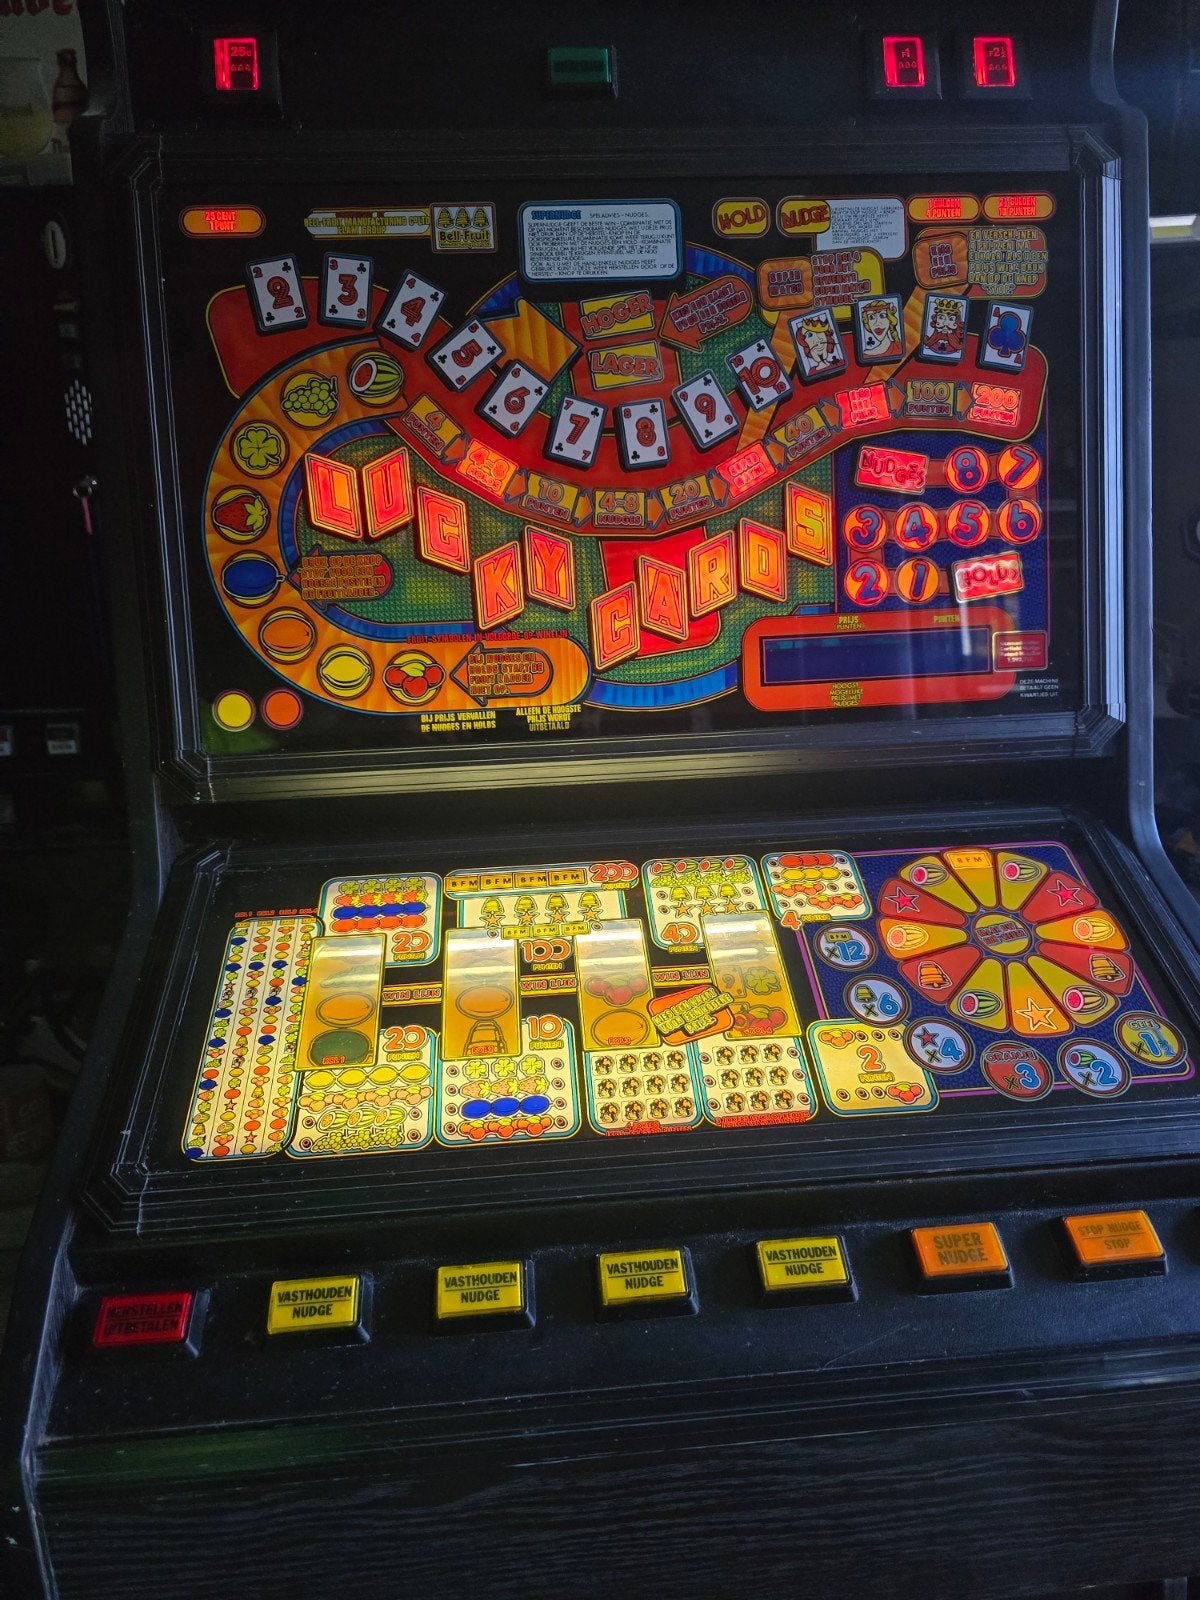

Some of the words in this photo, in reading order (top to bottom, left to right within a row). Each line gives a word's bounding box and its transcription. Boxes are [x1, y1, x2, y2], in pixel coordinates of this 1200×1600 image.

[934, 199, 961, 208] GULDEN
[1008, 207, 1036, 216] PUNTEN
[1009, 197, 1036, 208] GULDEN
[216, 211, 236, 221] CENT
[345, 216, 408, 227] MANUFACTURING
[531, 210, 581, 220] SUPERNUDGE
[717, 205, 767, 231] HOLD
[781, 204, 831, 230] NUDGE
[932, 208, 961, 217] PUNTEN
[362, 226, 386, 235] GROUP
[440, 230, 490, 241] Bell-Fruit
[812, 254, 835, 266] STOP
[770, 270, 802, 283] SUPER
[814, 273, 858, 285] GEWENSTE
[1015, 274, 1038, 283] KNOP
[267, 276, 294, 309] 2
[338, 274, 358, 305] 3
[770, 283, 803, 296] MATCH
[815, 285, 842, 296] SUPER
[843, 280, 870, 293] MATCH
[401, 297, 426, 327] 4
[580, 294, 656, 335] HOGER
[451, 339, 482, 367] 5
[591, 352, 660, 378] LAGER
[738, 356, 781, 395] 10
[504, 386, 530, 414] 6
[911, 381, 951, 402] 100
[976, 386, 1019, 410] 200
[694, 393, 717, 424] 9
[908, 403, 951, 415] PUNTEN
[973, 407, 1015, 423] PUNTEN
[426, 411, 446, 430] 4
[566, 413, 590, 444] 7
[784, 414, 814, 441] 40
[405, 412, 446, 452] PUNTEN
[635, 416, 657, 447] 8
[788, 427, 829, 457] PUNTEN
[860, 449, 926, 488] NUDGES
[955, 448, 983, 490] 8
[1004, 445, 1037, 487] 7
[466, 465, 503, 492] HOLDS
[539, 478, 564, 503] 10
[669, 479, 700, 504] 20
[527, 497, 570, 520] PUNTEN
[599, 491, 640, 512] 4-8
[668, 496, 711, 521] PUNTEN
[598, 513, 643, 525] NUDGES
[851, 507, 881, 548] 3
[901, 507, 932, 546] 4
[953, 503, 983, 545] 5
[1006, 501, 1037, 541] 6
[313, 458, 572, 622] LUCKY
[355, 554, 382, 566] KNOP
[596, 492, 828, 660] CARDS
[852, 562, 886, 603] 2
[911, 561, 930, 602] 1
[838, 616, 859, 624] PRIJS
[933, 615, 961, 624] PUNTEN
[407, 635, 429, 644] FRUIT
[485, 633, 522, 642] VOLGORDE
[536, 630, 569, 640] WINLIJN
[468, 654, 484, 665] BIJ
[486, 653, 521, 664] NUDGES
[468, 664, 498, 675] HOLDS
[531, 662, 544, 673] DE
[469, 675, 494, 685] FRUIT
[470, 685, 492, 695] NIET
[421, 714, 433, 724] BIJ
[434, 713, 455, 723] PRIJS
[457, 711, 496, 721] VERVALLEN
[516, 707, 542, 717] ALLEEN
[543, 706, 552, 715] DE
[552, 704, 582, 714] HOOGSTE
[527, 715, 546, 724] PRIJS
[547, 713, 571, 723] WORDT
[421, 723, 432, 733] DE
[434, 722, 460, 732] NUDGES
[462, 721, 473, 731] EN
[474, 720, 497, 730] HOLDS
[529, 722, 570, 732] UITBETAALD
[590, 864, 639, 883] 200
[781, 910, 802, 930] 4
[661, 922, 699, 944] 40
[391, 931, 432, 955] 20
[521, 938, 572, 962] 100
[393, 952, 425, 961] PUNTEN
[533, 962, 563, 971] PUNTEN
[654, 971, 681, 981] WIN
[682, 969, 709, 980] LIJN
[520, 980, 548, 991] WIN
[549, 978, 578, 989] LIJN
[383, 990, 410, 1001] WIN
[412, 988, 441, 999] LIJN
[652, 1009, 673, 1026] KIES
[671, 1001, 690, 1016] EEN
[688, 988, 718, 1007] KAART
[526, 1014, 564, 1041] 10
[658, 1016, 685, 1034] VOOR
[383, 1024, 428, 1052] 20
[529, 1040, 564, 1049] PUNTEN
[857, 1045, 886, 1073] 2
[984, 1049, 1037, 1064] ORANJE
[1077, 1222, 1104, 1236] STOP
[1106, 1220, 1144, 1235] NUDGE
[932, 1232, 983, 1249] SUPER
[1103, 1236, 1131, 1251] STOP
[764, 1244, 837, 1262] VASTHOUDEN
[937, 1247, 989, 1265] NUDGE
[606, 1258, 679, 1275] VASTHOUDEN
[784, 1261, 824, 1276] NUDGE
[443, 1271, 518, 1289] VASTHOUDEN
[625, 1275, 664, 1290] NUDGE
[277, 1286, 353, 1303] VASTHOUDEN
[460, 1289, 501, 1304] NUDGE
[292, 1304, 334, 1320] NUDGE
